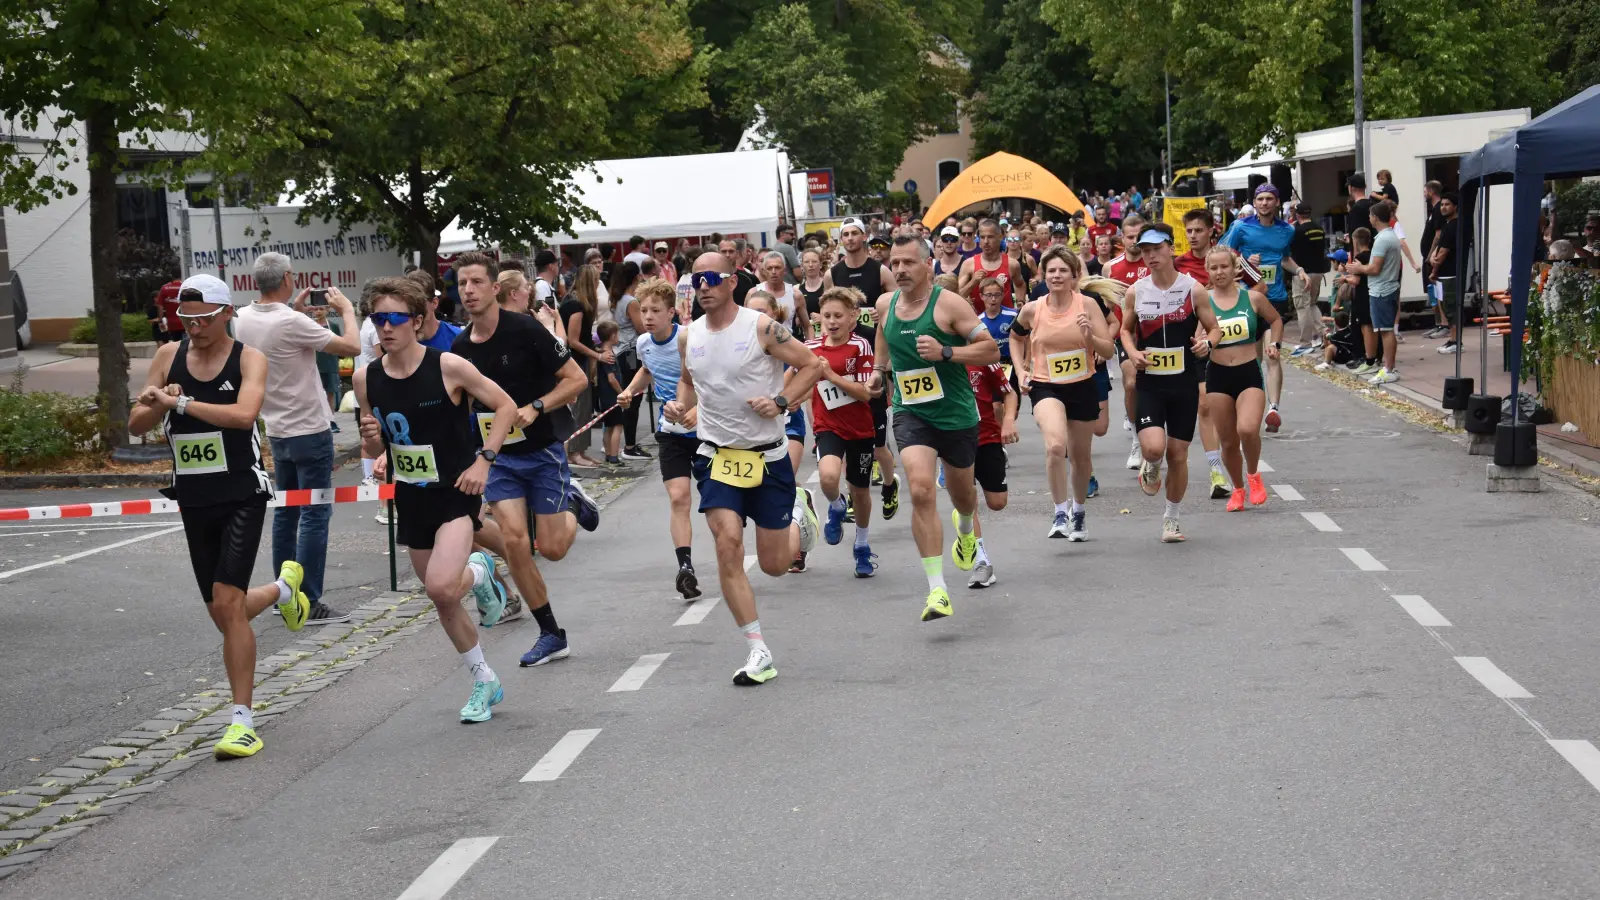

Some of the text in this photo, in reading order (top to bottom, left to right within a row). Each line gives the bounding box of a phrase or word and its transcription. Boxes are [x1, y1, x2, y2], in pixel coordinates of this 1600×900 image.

[971, 171, 1032, 184] HÖGNER
[324, 235, 346, 257] FÜR
[348, 235, 366, 255] EIN
[338, 270, 356, 288] !!!!
[1054, 357, 1081, 374] 573
[1152, 354, 1175, 367] 511
[903, 376, 934, 395] 578
[180, 442, 217, 463] 646
[396, 454, 428, 473] 634
[721, 459, 754, 479] 512
